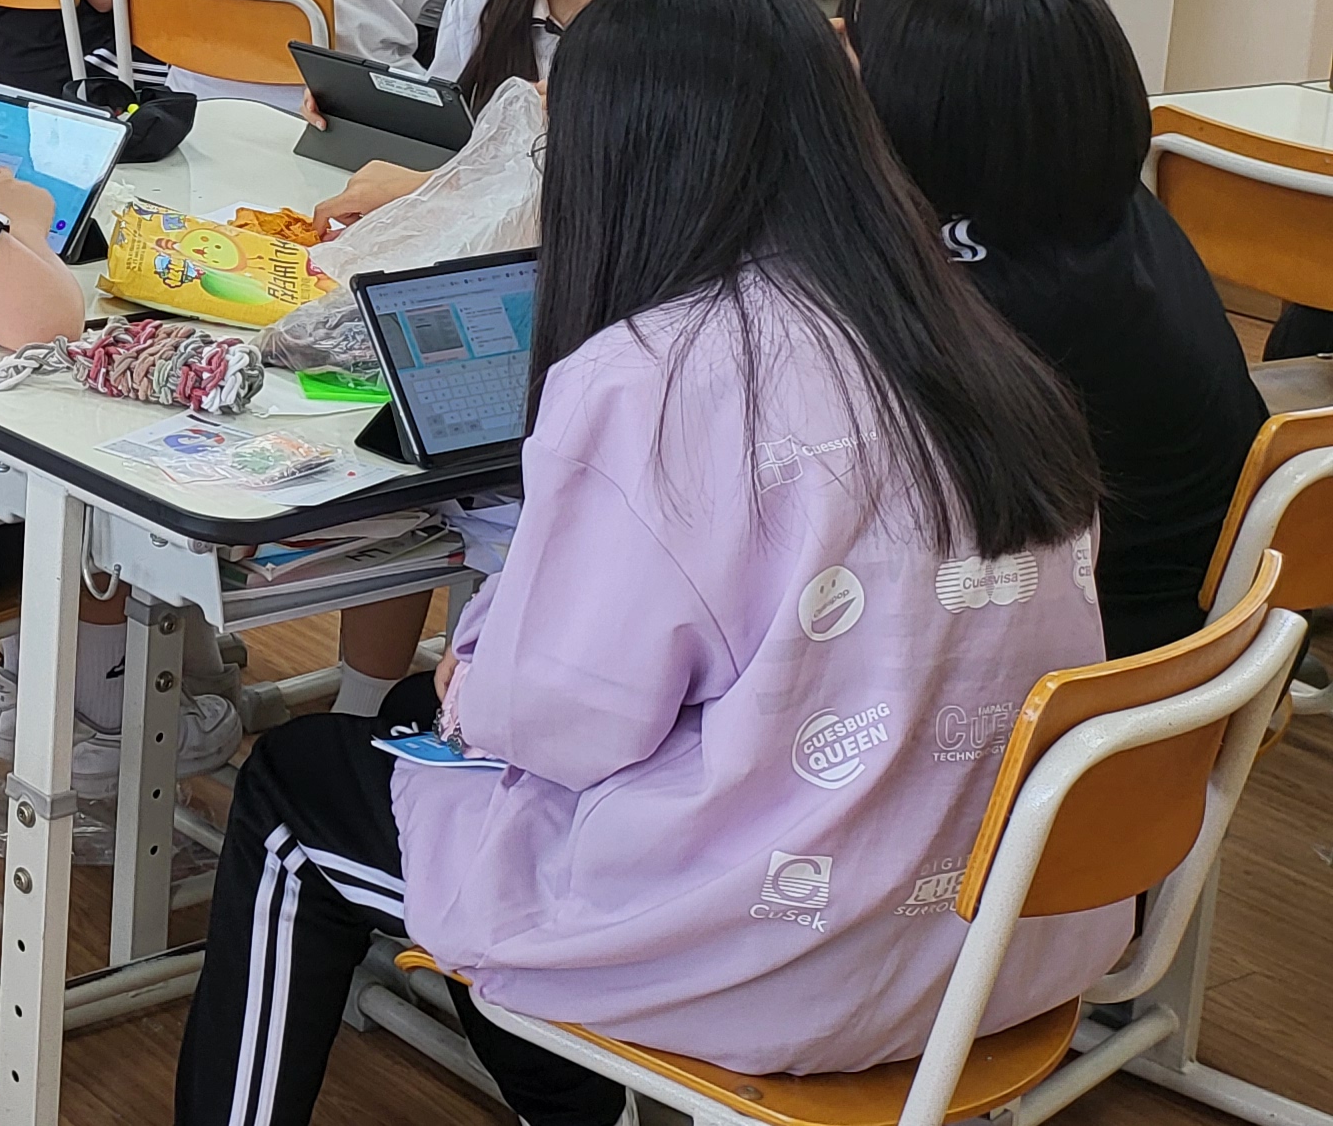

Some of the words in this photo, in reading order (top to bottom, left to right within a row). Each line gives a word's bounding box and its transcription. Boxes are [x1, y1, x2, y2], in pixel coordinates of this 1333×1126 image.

[803, 702, 891, 754] CUESBURG
[978, 702, 1014, 716] IMPACT
[808, 723, 889, 772] QUEEN
